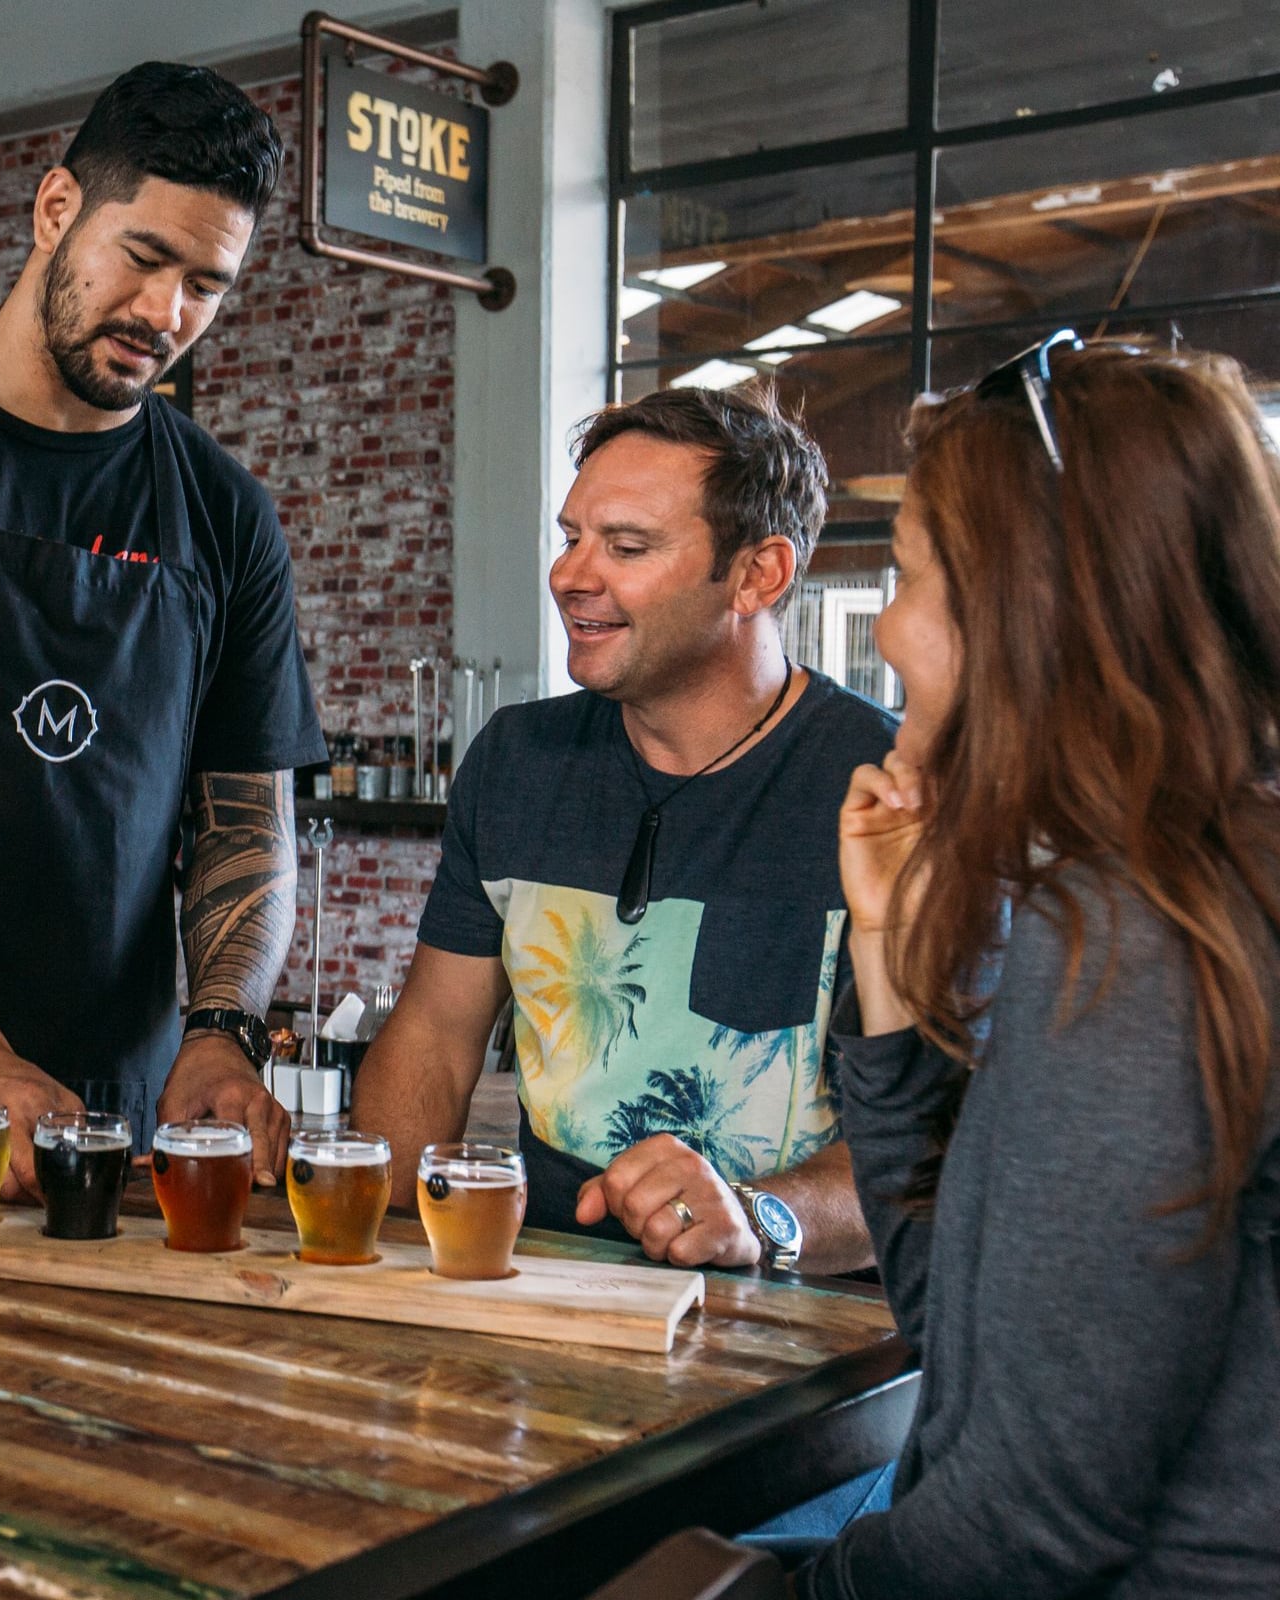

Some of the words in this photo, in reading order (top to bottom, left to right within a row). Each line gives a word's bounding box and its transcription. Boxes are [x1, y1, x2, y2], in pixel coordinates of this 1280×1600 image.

[347, 91, 470, 182] STOKE
[373, 165, 412, 196] Piped
[414, 177, 445, 205] from
[368, 190, 393, 216] the
[394, 196, 449, 233] brewery
[37, 698, 77, 743] M
